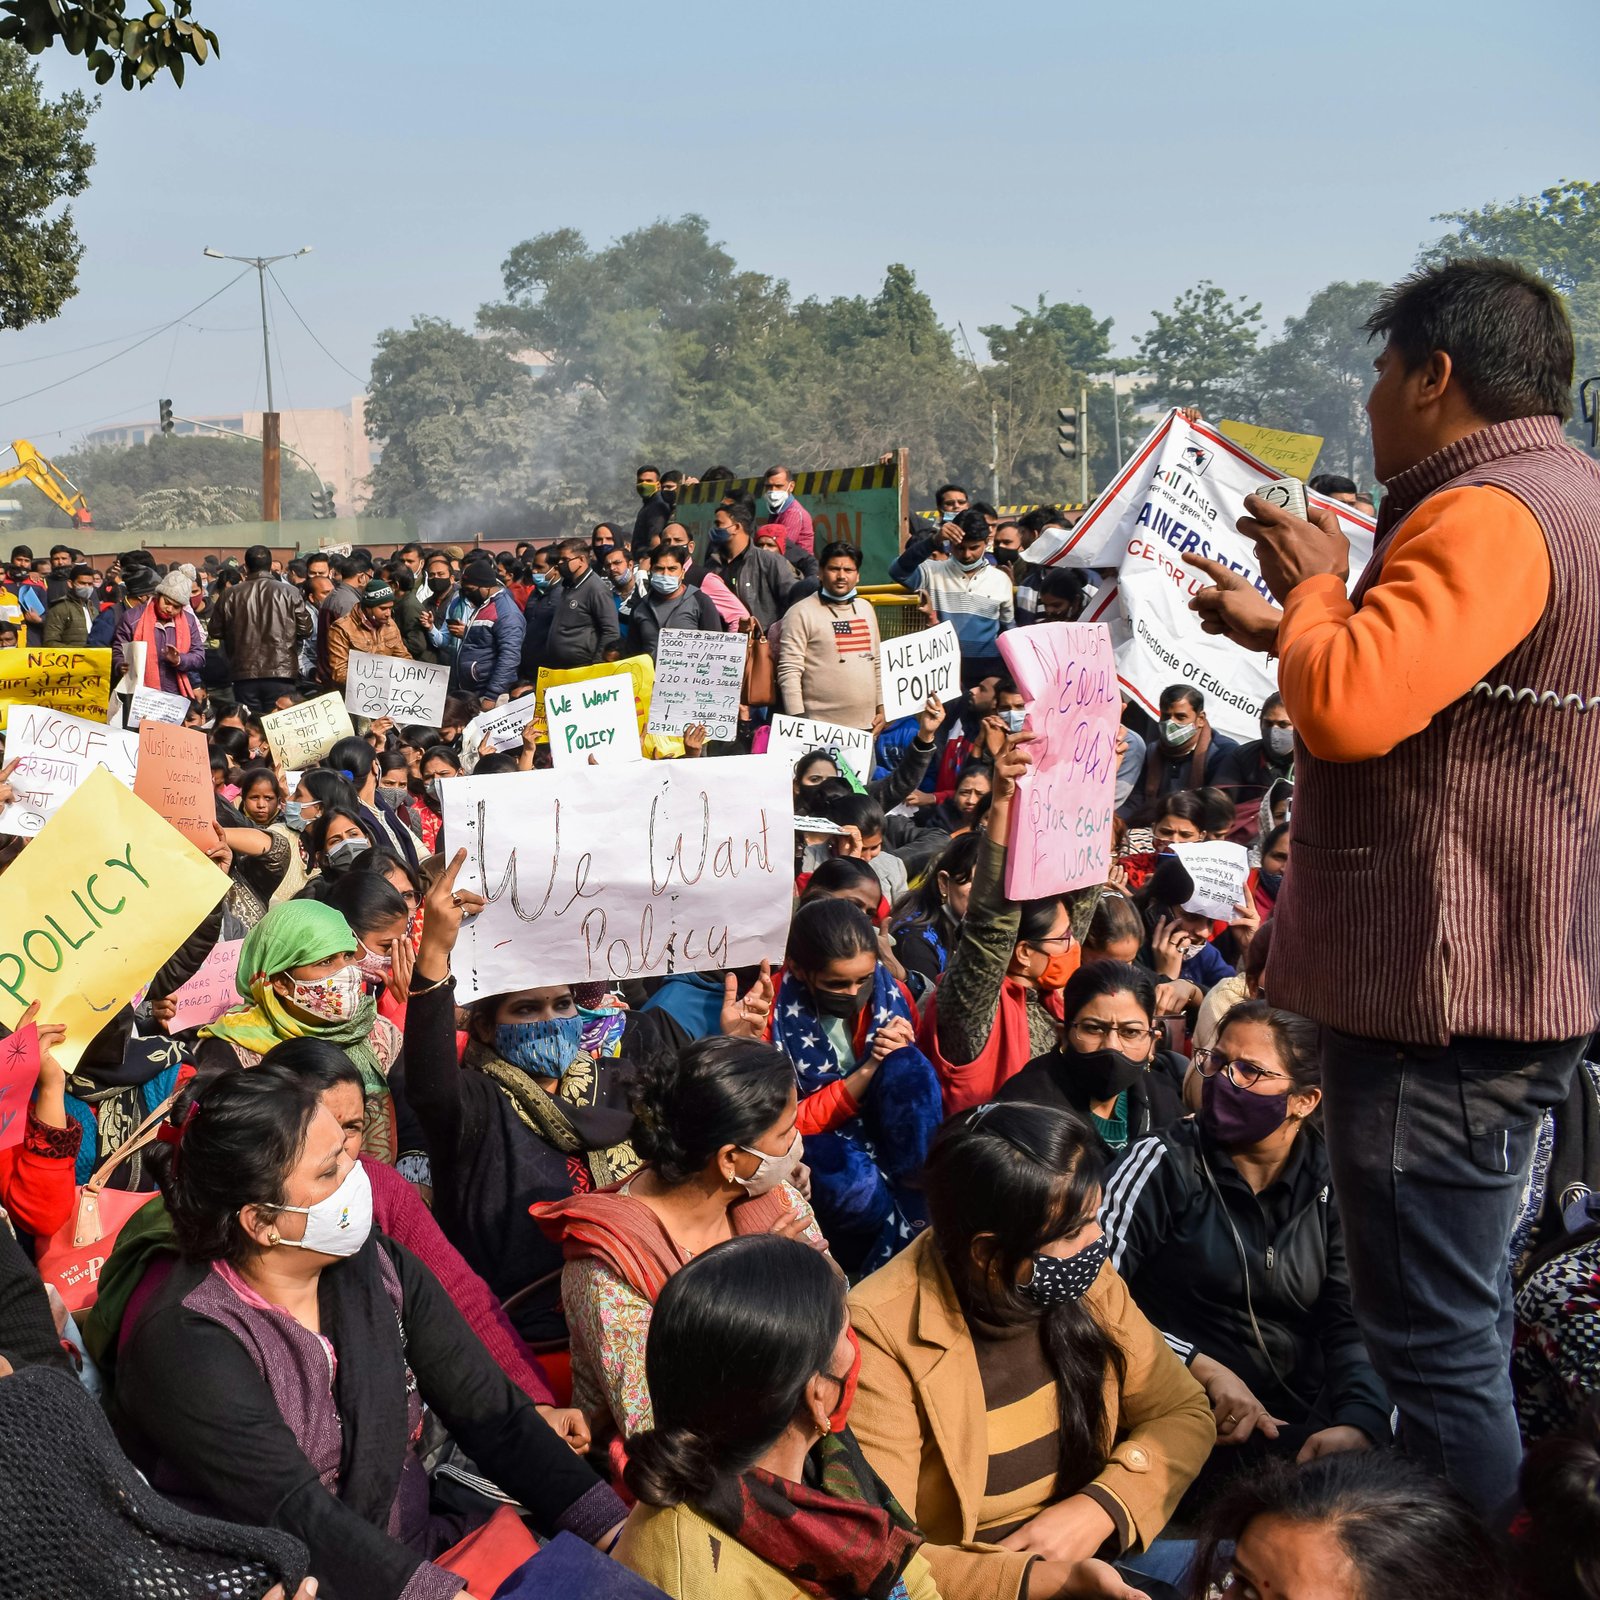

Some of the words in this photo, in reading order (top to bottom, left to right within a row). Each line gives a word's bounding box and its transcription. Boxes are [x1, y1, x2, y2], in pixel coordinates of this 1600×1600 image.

[1182, 482, 1218, 521] India
[1158, 554, 1185, 587] FOR
[28, 652, 85, 668] NSQF
[888, 645, 914, 672] WE
[918, 631, 954, 663] WANT
[1137, 619, 1180, 670] Directorate
[1182, 663, 1200, 681] Of
[356, 659, 383, 679] WE
[389, 665, 440, 684] WANT
[660, 673, 680, 683] 220
[898, 662, 952, 706] POLICY
[356, 682, 424, 707] POLICY
[582, 689, 619, 709] WANT
[1059, 661, 1115, 714] EQUAL
[266, 716, 282, 731] WE
[362, 700, 382, 713] 60
[383, 702, 432, 721] YEARS
[482, 719, 509, 733] POLICY
[497, 719, 523, 734] POLICY
[779, 720, 805, 738] WE
[813, 725, 869, 750] WANT
[145, 728, 176, 758] Justice
[1068, 721, 1116, 784] PAY
[478, 798, 608, 923] We
[650, 791, 776, 897] Want
[1063, 845, 1104, 882] WORK
[0, 842, 150, 1006] POLICY
[581, 903, 729, 978] Policy
